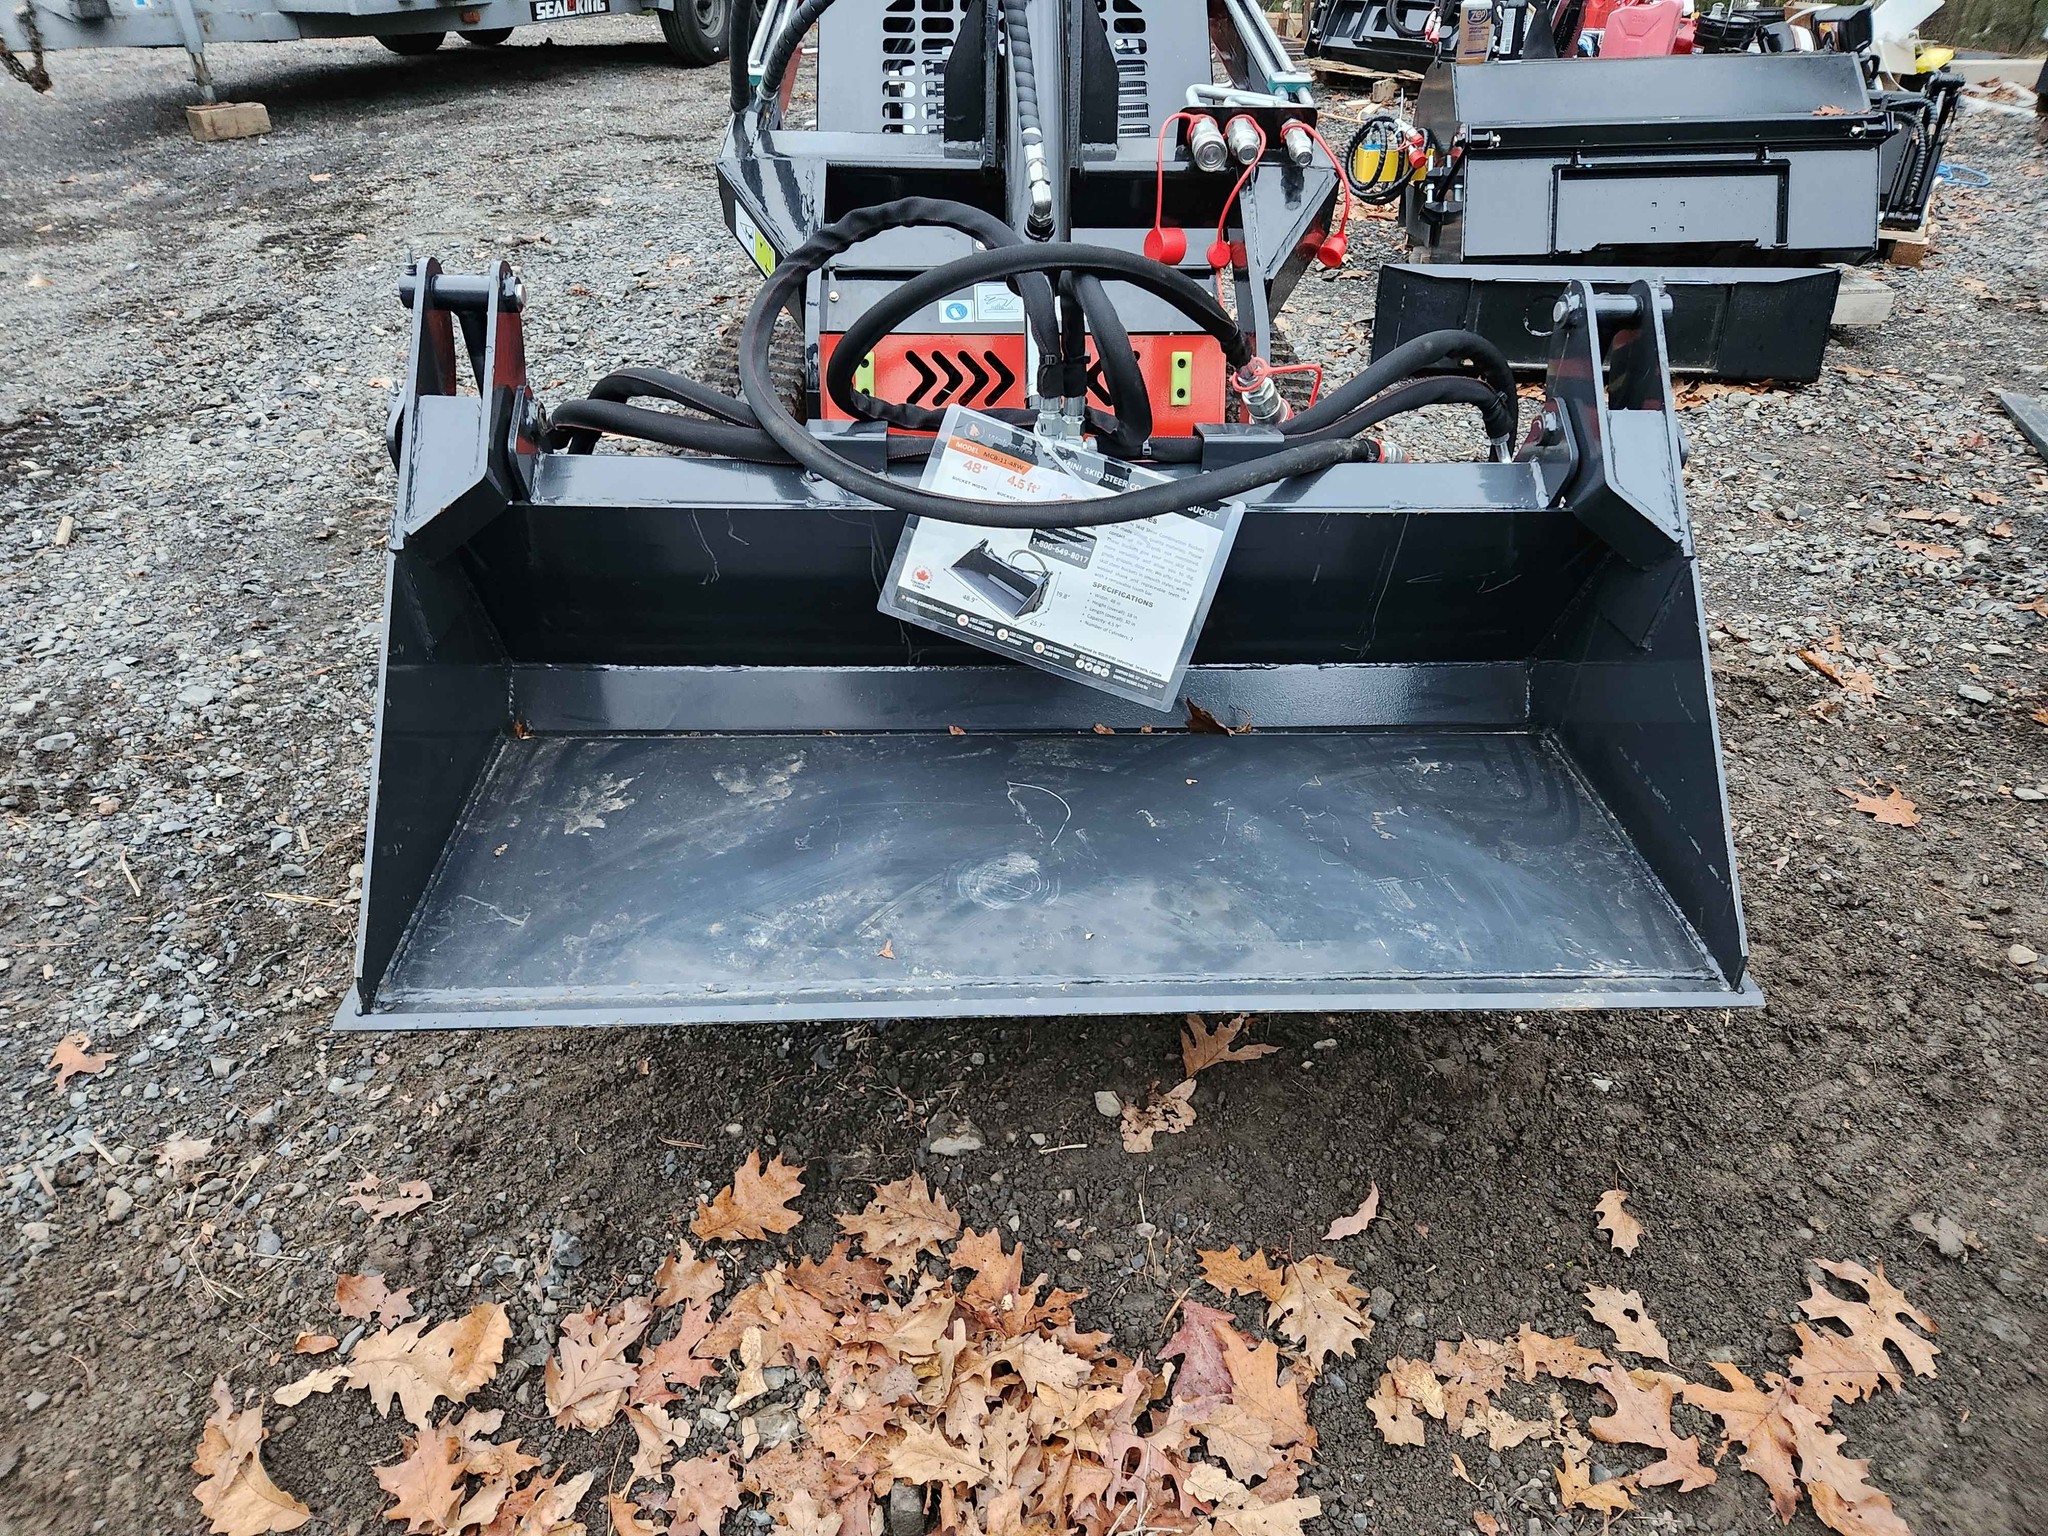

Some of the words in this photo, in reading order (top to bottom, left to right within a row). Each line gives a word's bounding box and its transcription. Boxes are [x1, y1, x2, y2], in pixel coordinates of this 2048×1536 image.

[988, 433, 1033, 456] Wolverine
[955, 441, 979, 454] MODEL
[983, 451, 1025, 470] MCB-11-48W
[1063, 459, 1082, 472] MINI
[1085, 466, 1104, 480] SKID
[1103, 473, 1129, 489] STEER
[952, 475, 971, 486] BUCKET
[971, 482, 988, 491] WIDTH
[1007, 475, 1026, 490] 4.5
[996, 490, 1016, 501] BUCKET
[1032, 538, 1089, 563] 1-800-649-8017
[1056, 590, 1071, 600] 19.8"
[1092, 581, 1154, 608] SPECIFICATIONS
[1089, 607, 1105, 617] Length
[1029, 619, 1046, 629] 25.7"
